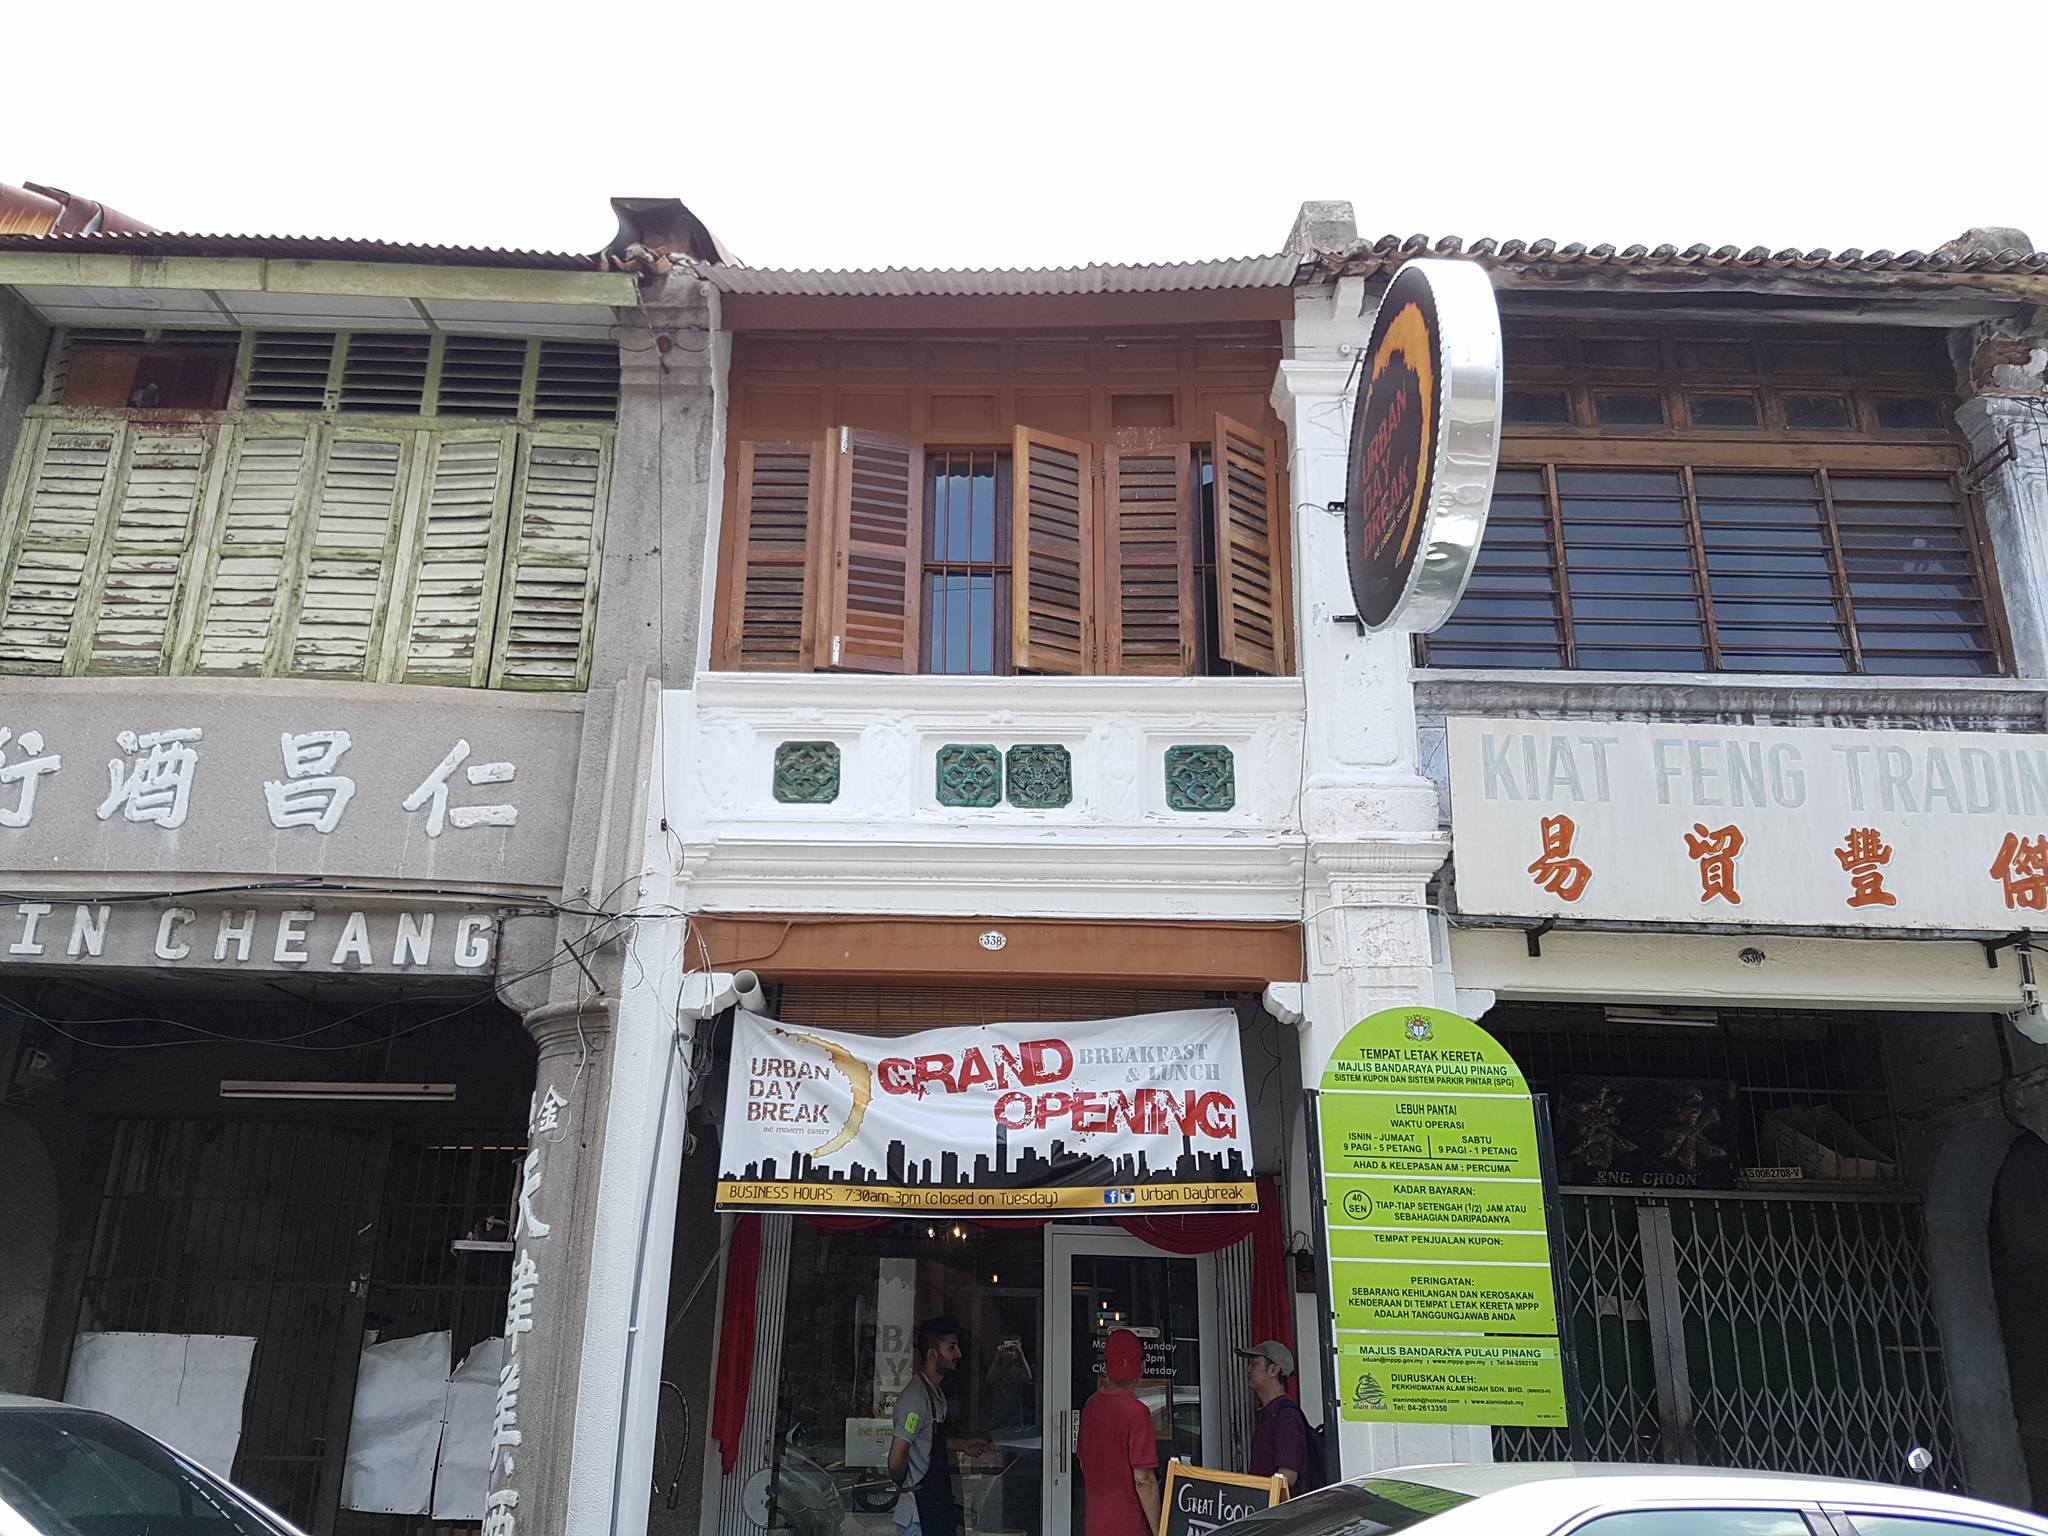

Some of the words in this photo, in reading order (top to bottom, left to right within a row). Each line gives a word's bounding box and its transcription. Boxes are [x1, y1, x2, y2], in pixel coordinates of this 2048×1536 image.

[1481, 732, 1619, 803] KIAT
[1652, 738, 1805, 809] FENG
[9, 903, 112, 957] IN
[154, 907, 496, 968] CHEANG
[984, 934, 1002, 947] 338
[1079, 1043, 1208, 1065] BREAKFAST
[1360, 1049, 1401, 1059] TEMPAT
[1404, 1050, 1438, 1060] LETAK
[1441, 1051, 1484, 1062] KERETA
[751, 1057, 830, 1080] URBAN
[877, 1038, 1074, 1101] GRAND
[1125, 1067, 1140, 1083] &
[1149, 1063, 1221, 1081] LUNCH
[1338, 1062, 1372, 1073] MAJLIS
[1375, 1063, 1433, 1075] BANDARAYA
[1436, 1065, 1467, 1075] PULAU
[1471, 1066, 1507, 1077] PINANG
[1391, 1075, 1406, 1083] DAN
[1494, 1078, 1514, 1088] (SPG)
[749, 1079, 802, 1100] DAY
[747, 1101, 830, 1123] BREAK
[994, 1087, 1237, 1140] OPENING
[1396, 1104, 1425, 1114] LEBUH
[1427, 1104, 1457, 1115] PANTAI
[1390, 1120, 1422, 1128] WAKTU
[1425, 1121, 1464, 1129] OPERASI
[1349, 1132, 1371, 1140] ISNIN
[1379, 1134, 1415, 1142] JUMAAT
[1462, 1136, 1492, 1144] SABTU
[1351, 1143, 1371, 1151] PAGI
[1386, 1144, 1422, 1153] PETANG
[1446, 1146, 1466, 1154] PAGI
[1481, 1147, 1517, 1155] PETANG
[1353, 1161, 1378, 1169] AHAD
[1381, 1161, 1387, 1169] &
[1390, 1162, 1443, 1170] KELEPASAN
[1466, 1164, 1511, 1172] PERCUMA
[1394, 1185, 1426, 1194] KADAR
[1429, 1186, 1475, 1195] BAYARAN:
[730, 1186, 789, 1199] BUSINESS
[794, 1187, 836, 1201] HOURS:
[845, 1188, 921, 1207] 7:30am-3pm
[926, 1191, 974, 1206] (closed
[978, 1194, 995, 1204] on
[1000, 1192, 1058, 1207] Tuesday)
[1141, 1187, 1179, 1201] Urban
[1184, 1186, 1243, 1203] Daybreak
[1352, 1194, 1362, 1202] 40
[1348, 1204, 1367, 1213] SEN
[1376, 1201, 1415, 1210] TIAP-TIAP
[1418, 1203, 1463, 1211] SETENGAH
[1505, 1205, 1526, 1213] ATAU
[1395, 1213, 1449, 1222] SEBAHAGIAN
[1451, 1214, 1510, 1223] DARIPADANYA
[1412, 1236, 1466, 1244] PENJUALAN
[1468, 1237, 1503, 1245] KUPON:
[1411, 1277, 1474, 1286] PERINGATAN:
[1352, 1288, 1399, 1296] SEBARANG
[1402, 1289, 1457, 1298] KEHILANGAN
[1480, 1291, 1534, 1299] KEROSAKAN
[1349, 1298, 1402, 1307] KENDERAAN
[1415, 1300, 1448, 1308] TEMPAT
[1450, 1301, 1478, 1309] LETAK
[1480, 1302, 1514, 1310] KERETA
[1515, 1303, 1539, 1312] MPPP
[1374, 1310, 1409, 1318] ADALAH
[1412, 1311, 1489, 1320] TANGGUNGJAWAB
[1492, 1313, 1516, 1321] ANDA
[1143, 1341, 1177, 1353] Sunday
[1360, 1346, 1397, 1357] MAJLIS
[1464, 1349, 1499, 1357] PULAU
[1502, 1347, 1541, 1359] PINANG
[1143, 1367, 1178, 1377] uesday
[1391, 1374, 1445, 1382] DIURUSKAN
[1448, 1375, 1476, 1383] OLEH:
[1408, 1403, 1447, 1411] 04-2613350
